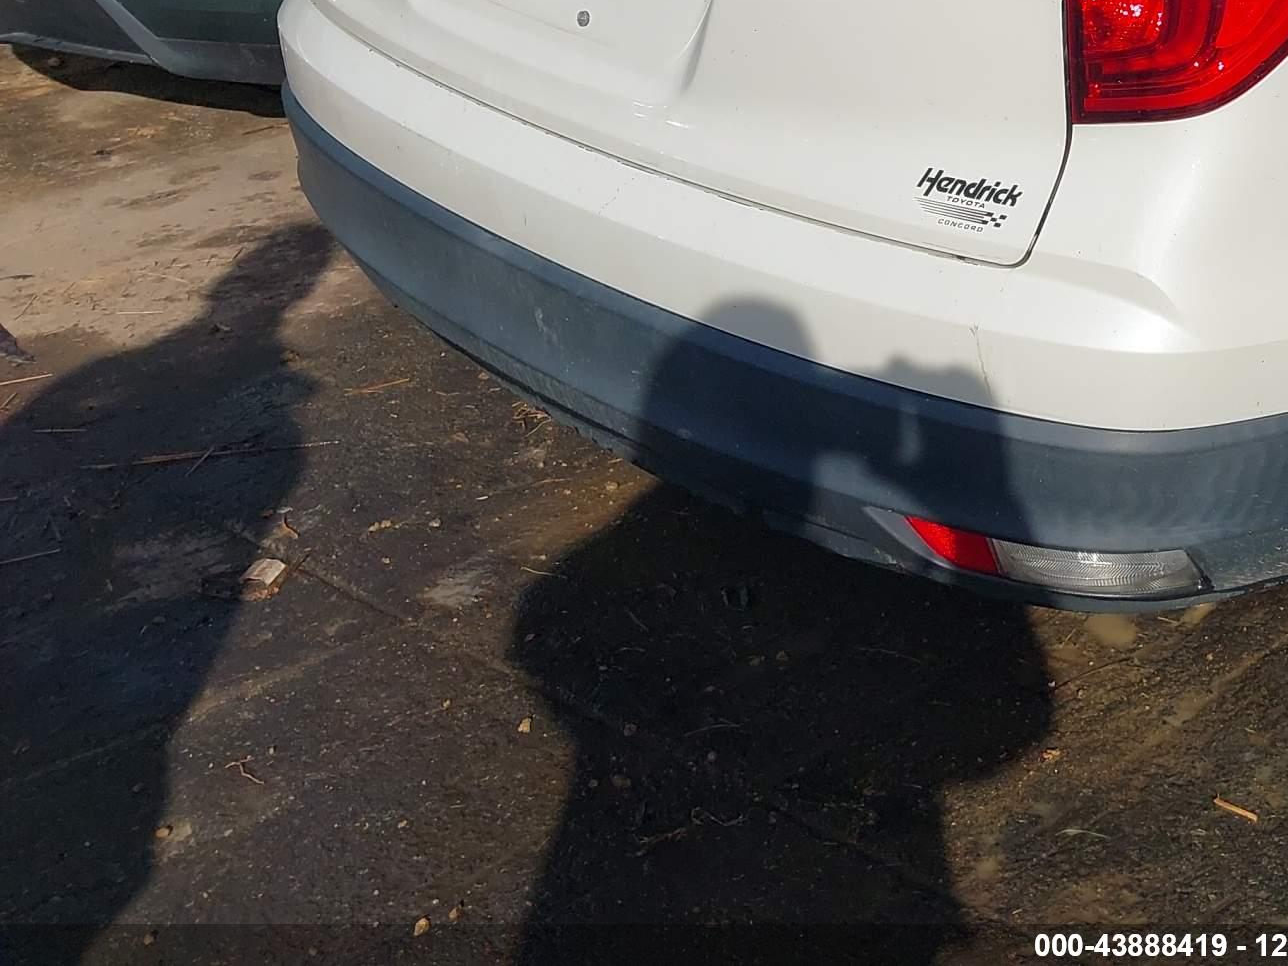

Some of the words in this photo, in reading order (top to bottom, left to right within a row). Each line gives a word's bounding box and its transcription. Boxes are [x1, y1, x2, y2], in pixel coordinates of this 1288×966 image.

[916, 167, 1023, 207] Hendrick
[946, 195, 986, 209] TOYOTA
[937, 218, 984, 233] CONCORD
